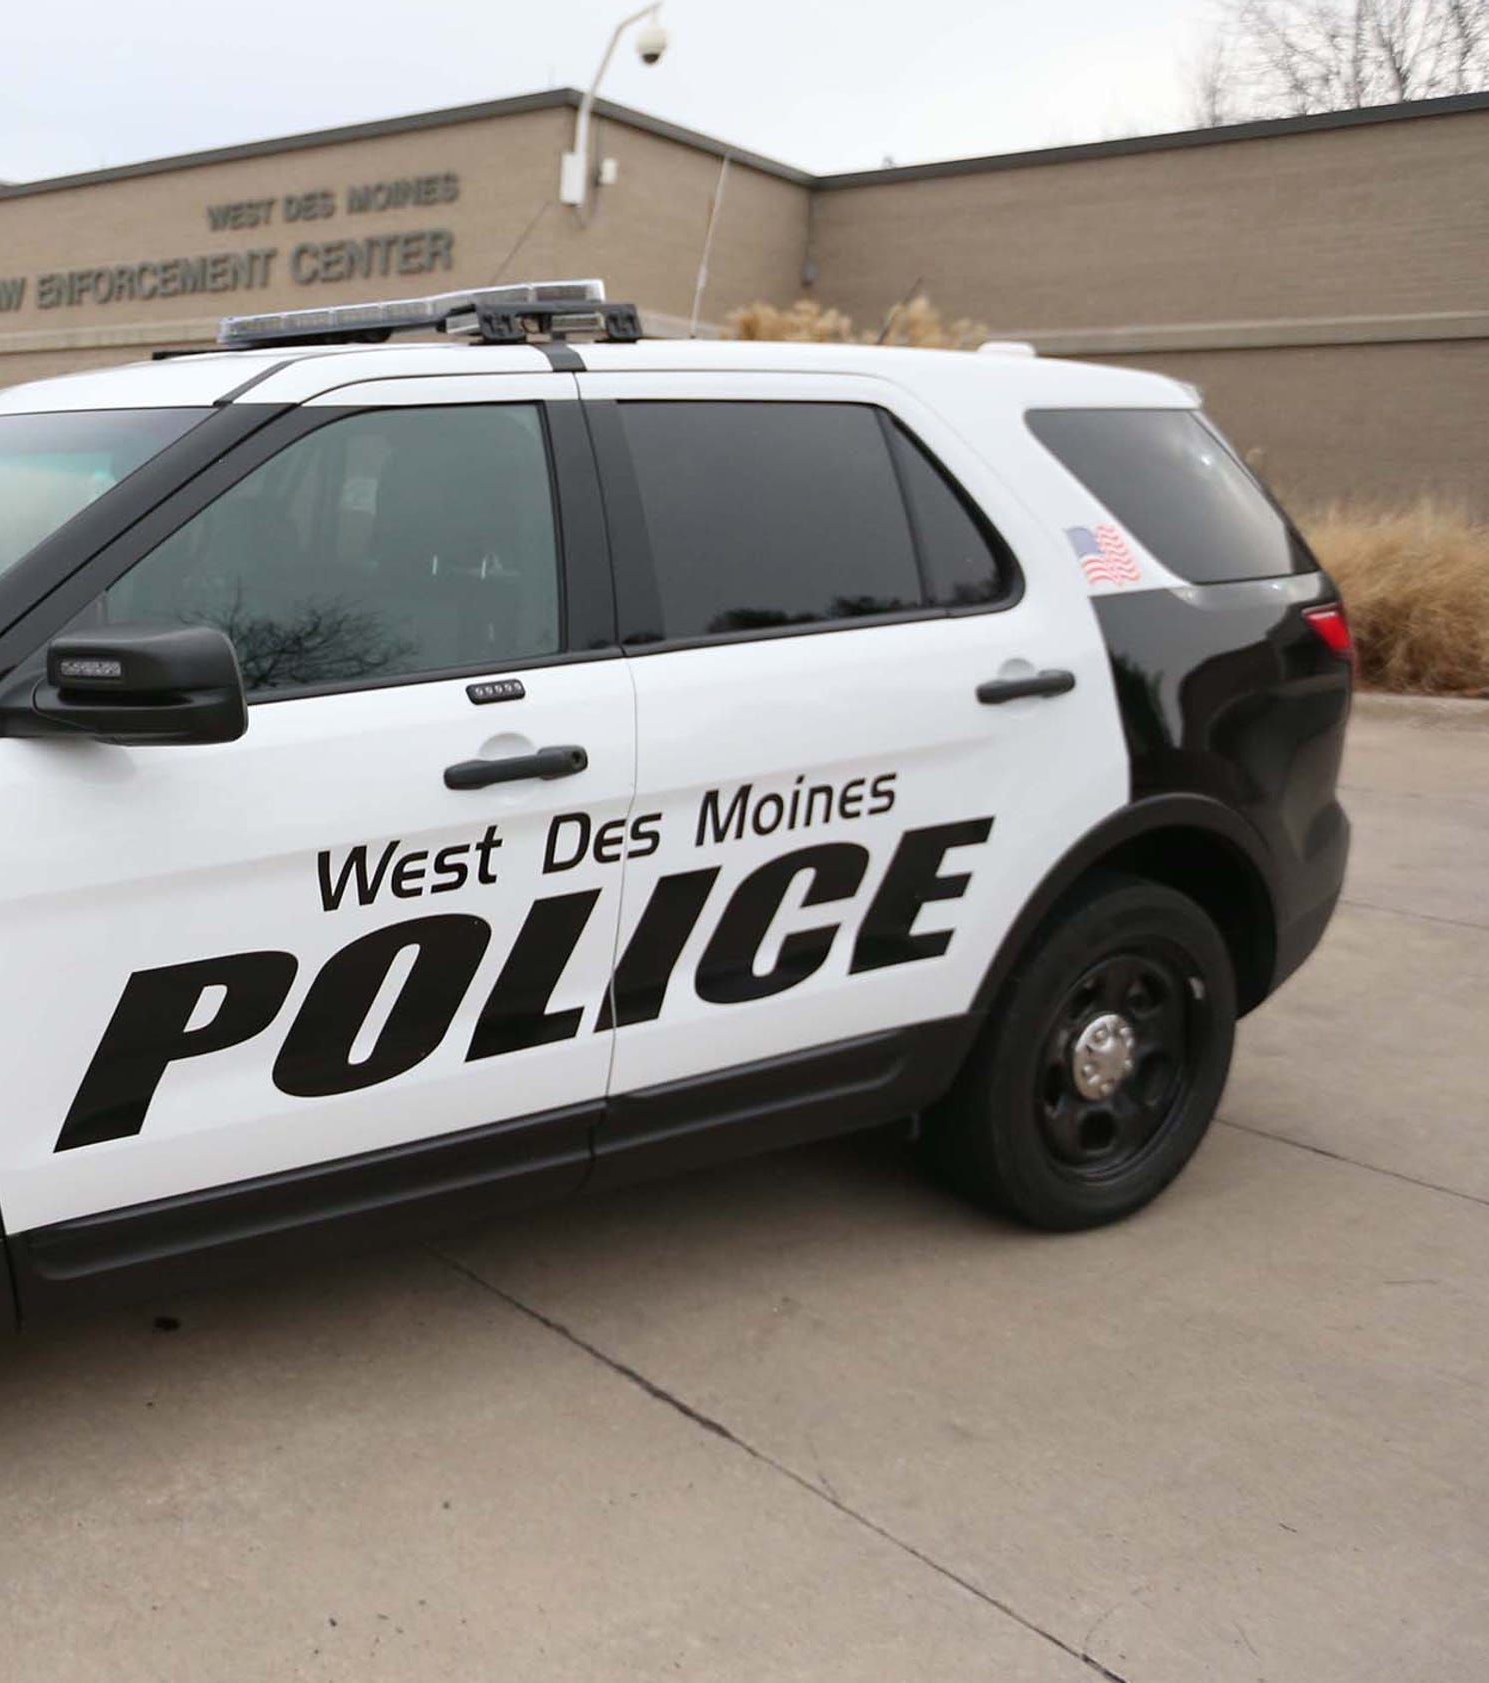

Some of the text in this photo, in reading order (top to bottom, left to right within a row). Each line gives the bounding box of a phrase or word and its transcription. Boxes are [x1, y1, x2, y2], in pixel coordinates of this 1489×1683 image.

[208, 172, 460, 231] WEST DES MOINES
[37, 248, 279, 309] ENFORCEMENT
[290, 228, 454, 286] CENTER
[316, 773, 897, 912] West Des Moines
[52, 816, 996, 1153] POLICE
